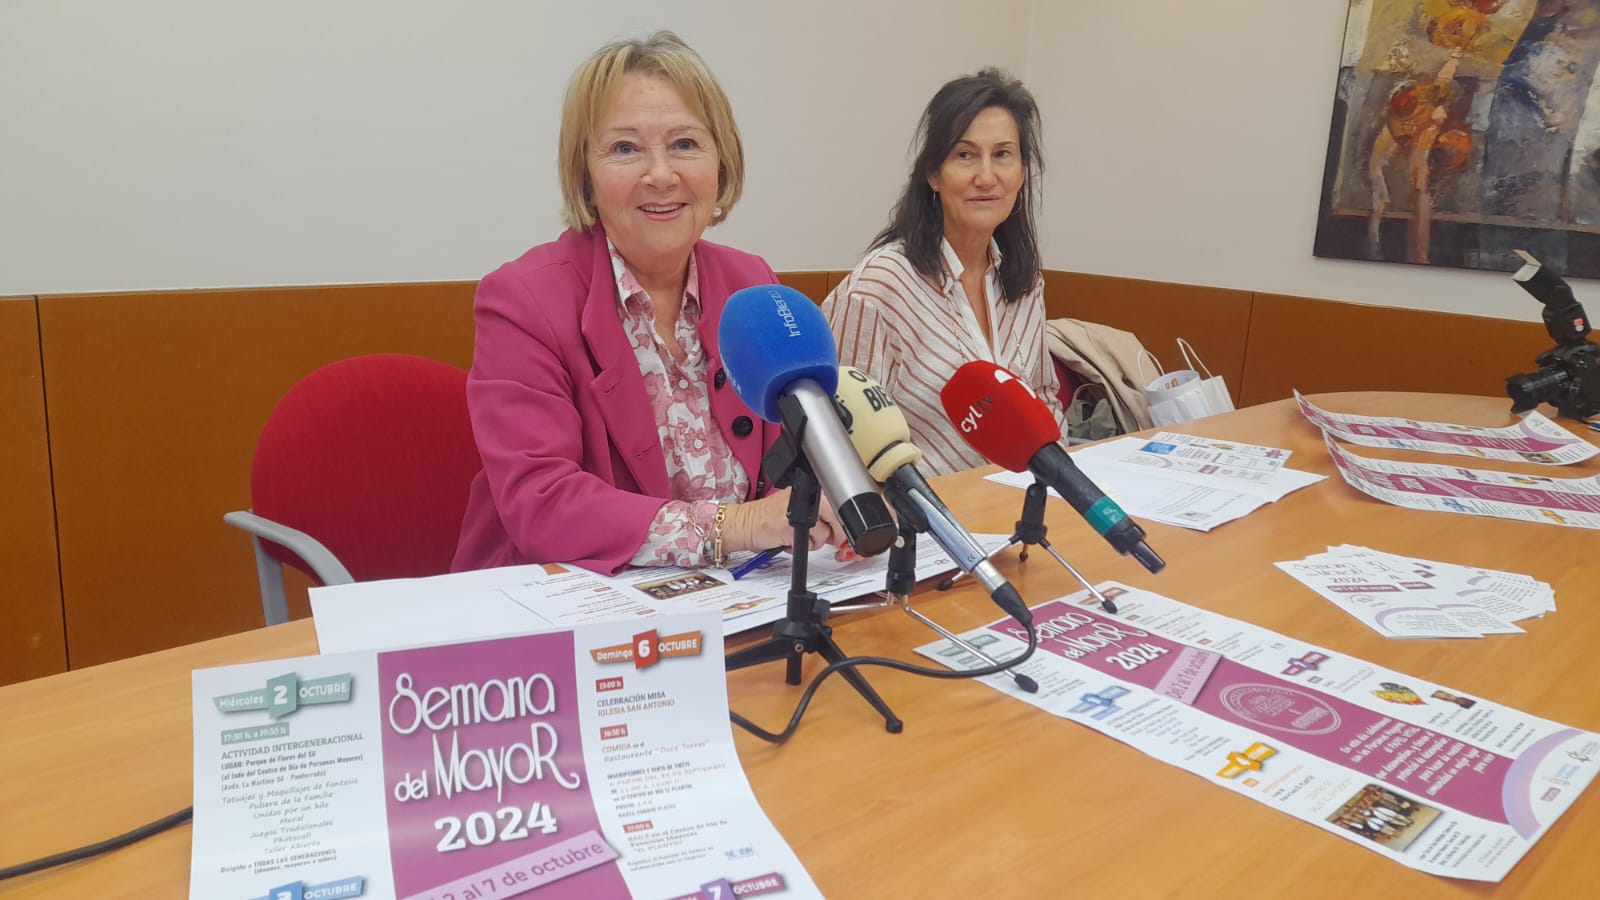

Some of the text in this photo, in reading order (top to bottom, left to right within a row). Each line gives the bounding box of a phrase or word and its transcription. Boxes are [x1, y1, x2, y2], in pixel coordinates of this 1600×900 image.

[597, 639, 697, 660] Domingo 6 OCTUBRE
[1106, 642, 1169, 671] 2024
[220, 682, 347, 708] Miércoles 2 OCTUBRE
[389, 673, 556, 734] Semana
[597, 692, 666, 708] CELEBRACIÓN MISA
[598, 699, 674, 717] IGLESIA SAN ANTONIO
[221, 733, 364, 760] ACTIVIDAD INTERGENERACIONAL
[602, 744, 631, 754] COMIDA
[246, 759, 267, 768] Parque
[278, 754, 295, 762] Flores
[604, 750, 652, 762] Restaurante
[257, 766, 277, 776] Centro
[309, 758, 335, 768] Personas
[394, 769, 428, 802] del
[221, 794, 255, 805] Tatuajes
[266, 785, 310, 798] Maquillajes
[249, 801, 278, 811] Pulsera
[305, 792, 333, 802] Familia
[254, 808, 281, 819] Unidos
[284, 807, 298, 816] por
[314, 802, 329, 810] hilo
[250, 820, 333, 839] Juegos Tradicionales
[280, 816, 304, 825] Mural
[434, 801, 557, 853] 2024
[273, 832, 310, 844] Photocall
[264, 841, 320, 854] Taller Abierto
[462, 883, 480, 900] al
[482, 879, 495, 893] 7
[502, 868, 528, 887] de
[531, 842, 604, 877] octubre
[304, 883, 357, 900] OCTUBRE
[733, 878, 778, 894] OCTUBRE
